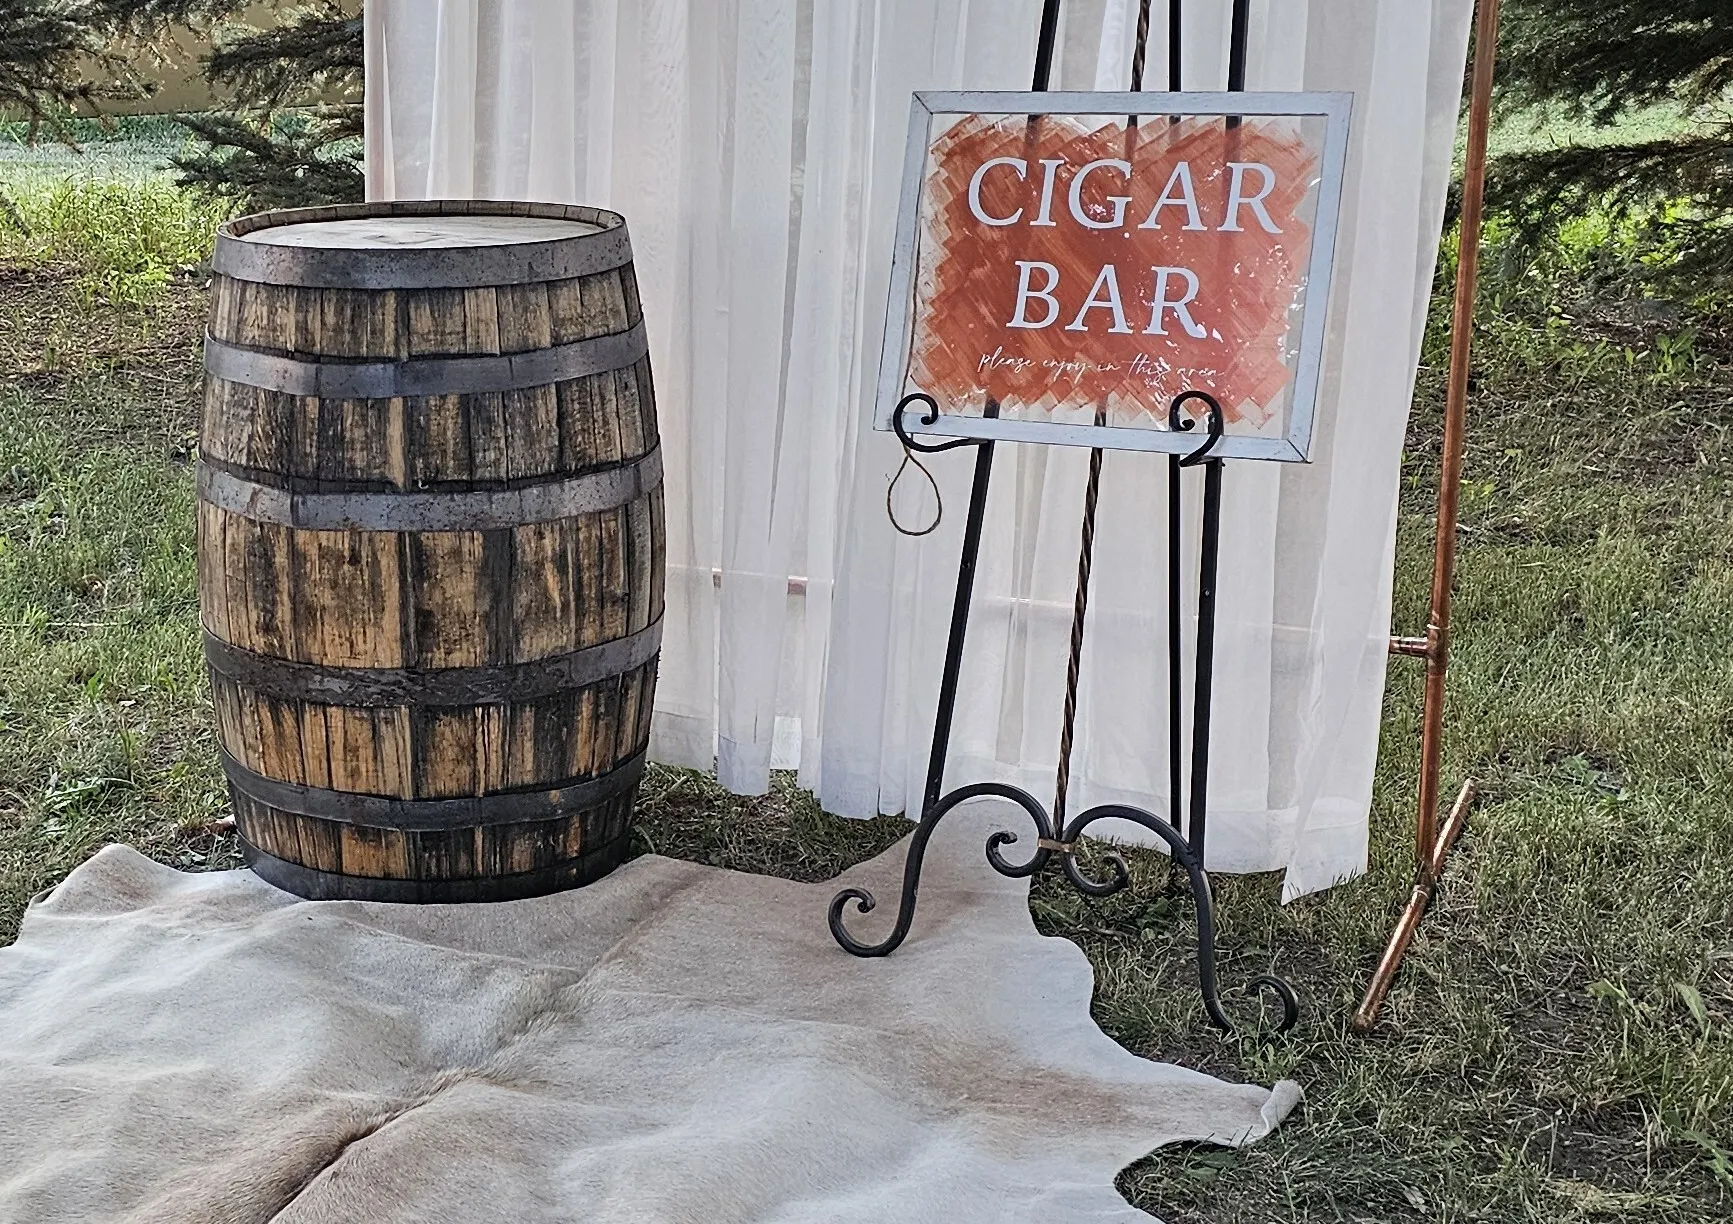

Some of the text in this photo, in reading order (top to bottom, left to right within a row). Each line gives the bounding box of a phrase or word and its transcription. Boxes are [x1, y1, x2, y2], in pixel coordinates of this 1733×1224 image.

[967, 157, 1284, 234] CIGAR
[1005, 260, 1208, 339] BAR
[977, 345, 1036, 373] please
[1042, 358, 1093, 385] enjoy
[1096, 361, 1121, 373] in
[1121, 352, 1172, 377] this
